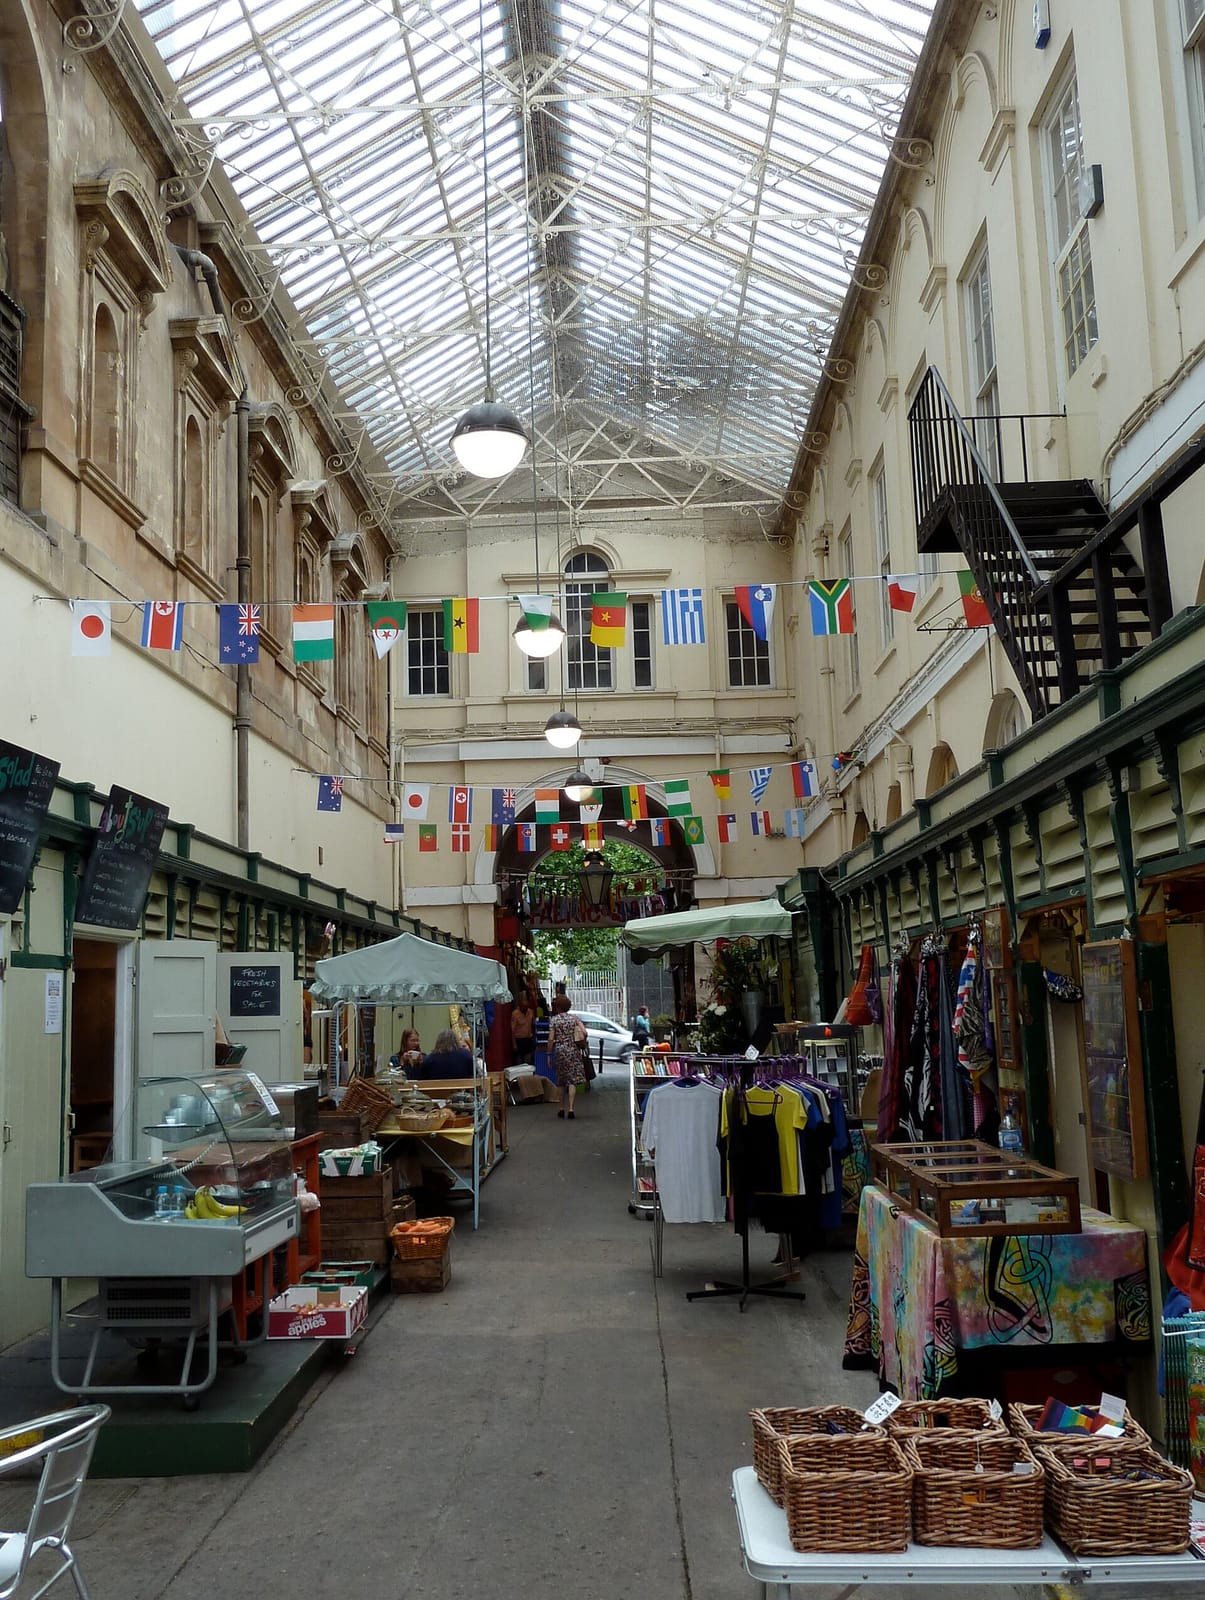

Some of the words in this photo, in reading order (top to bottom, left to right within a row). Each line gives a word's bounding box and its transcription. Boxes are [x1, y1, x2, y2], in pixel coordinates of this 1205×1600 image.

[241, 968, 268, 977] FRESH
[233, 979, 277, 988] VEGETABLES
[241, 1000, 272, 1009] SALE
[288, 1317, 327, 1336] apples
